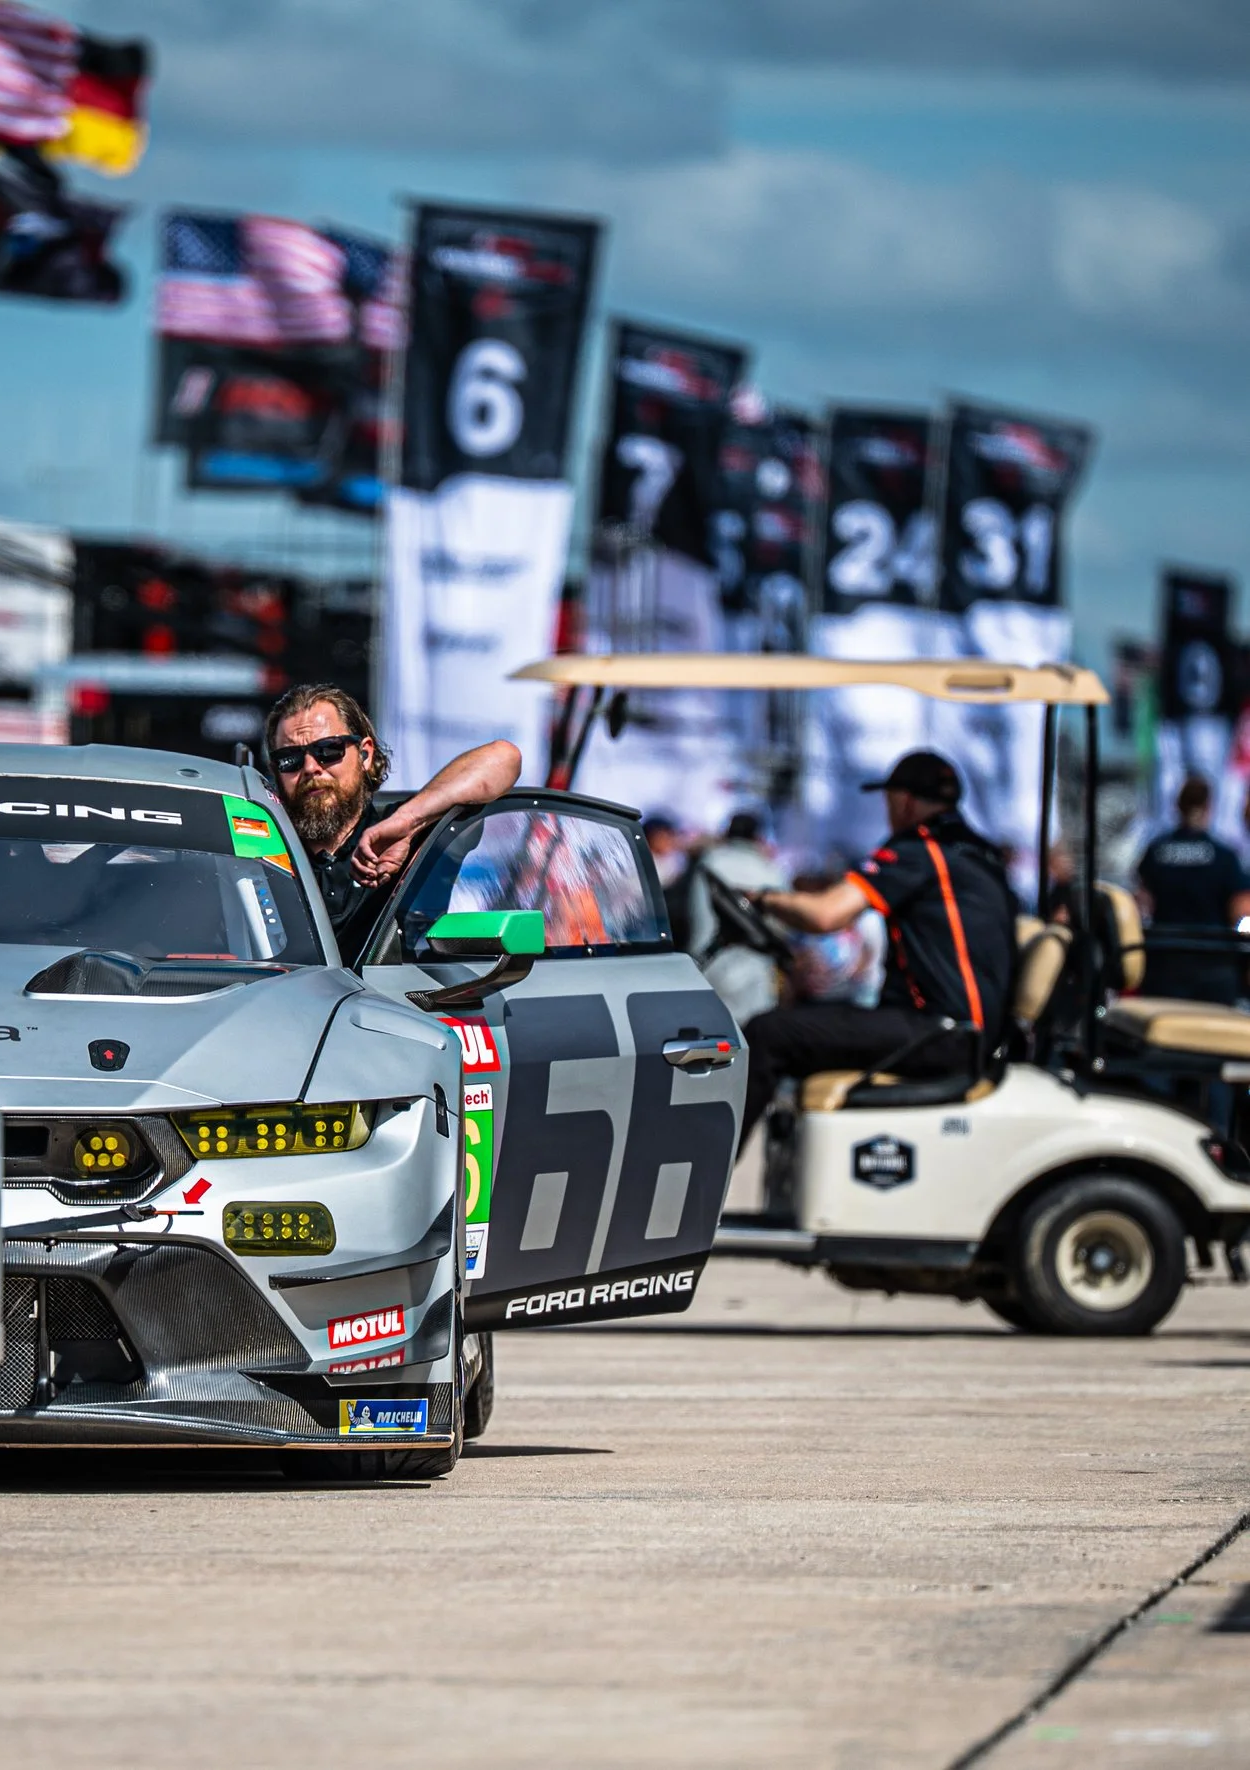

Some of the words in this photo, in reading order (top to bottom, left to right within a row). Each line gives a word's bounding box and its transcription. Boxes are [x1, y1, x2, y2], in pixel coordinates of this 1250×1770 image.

[447, 337, 527, 458] 6
[958, 496, 1053, 595] 31
[472, 989, 740, 1290] 66
[332, 1309, 402, 1345] MOTUL
[505, 1287, 586, 1320] FORD
[589, 1269, 695, 1306] RACING
[376, 1410, 422, 1424] MICHELIN
